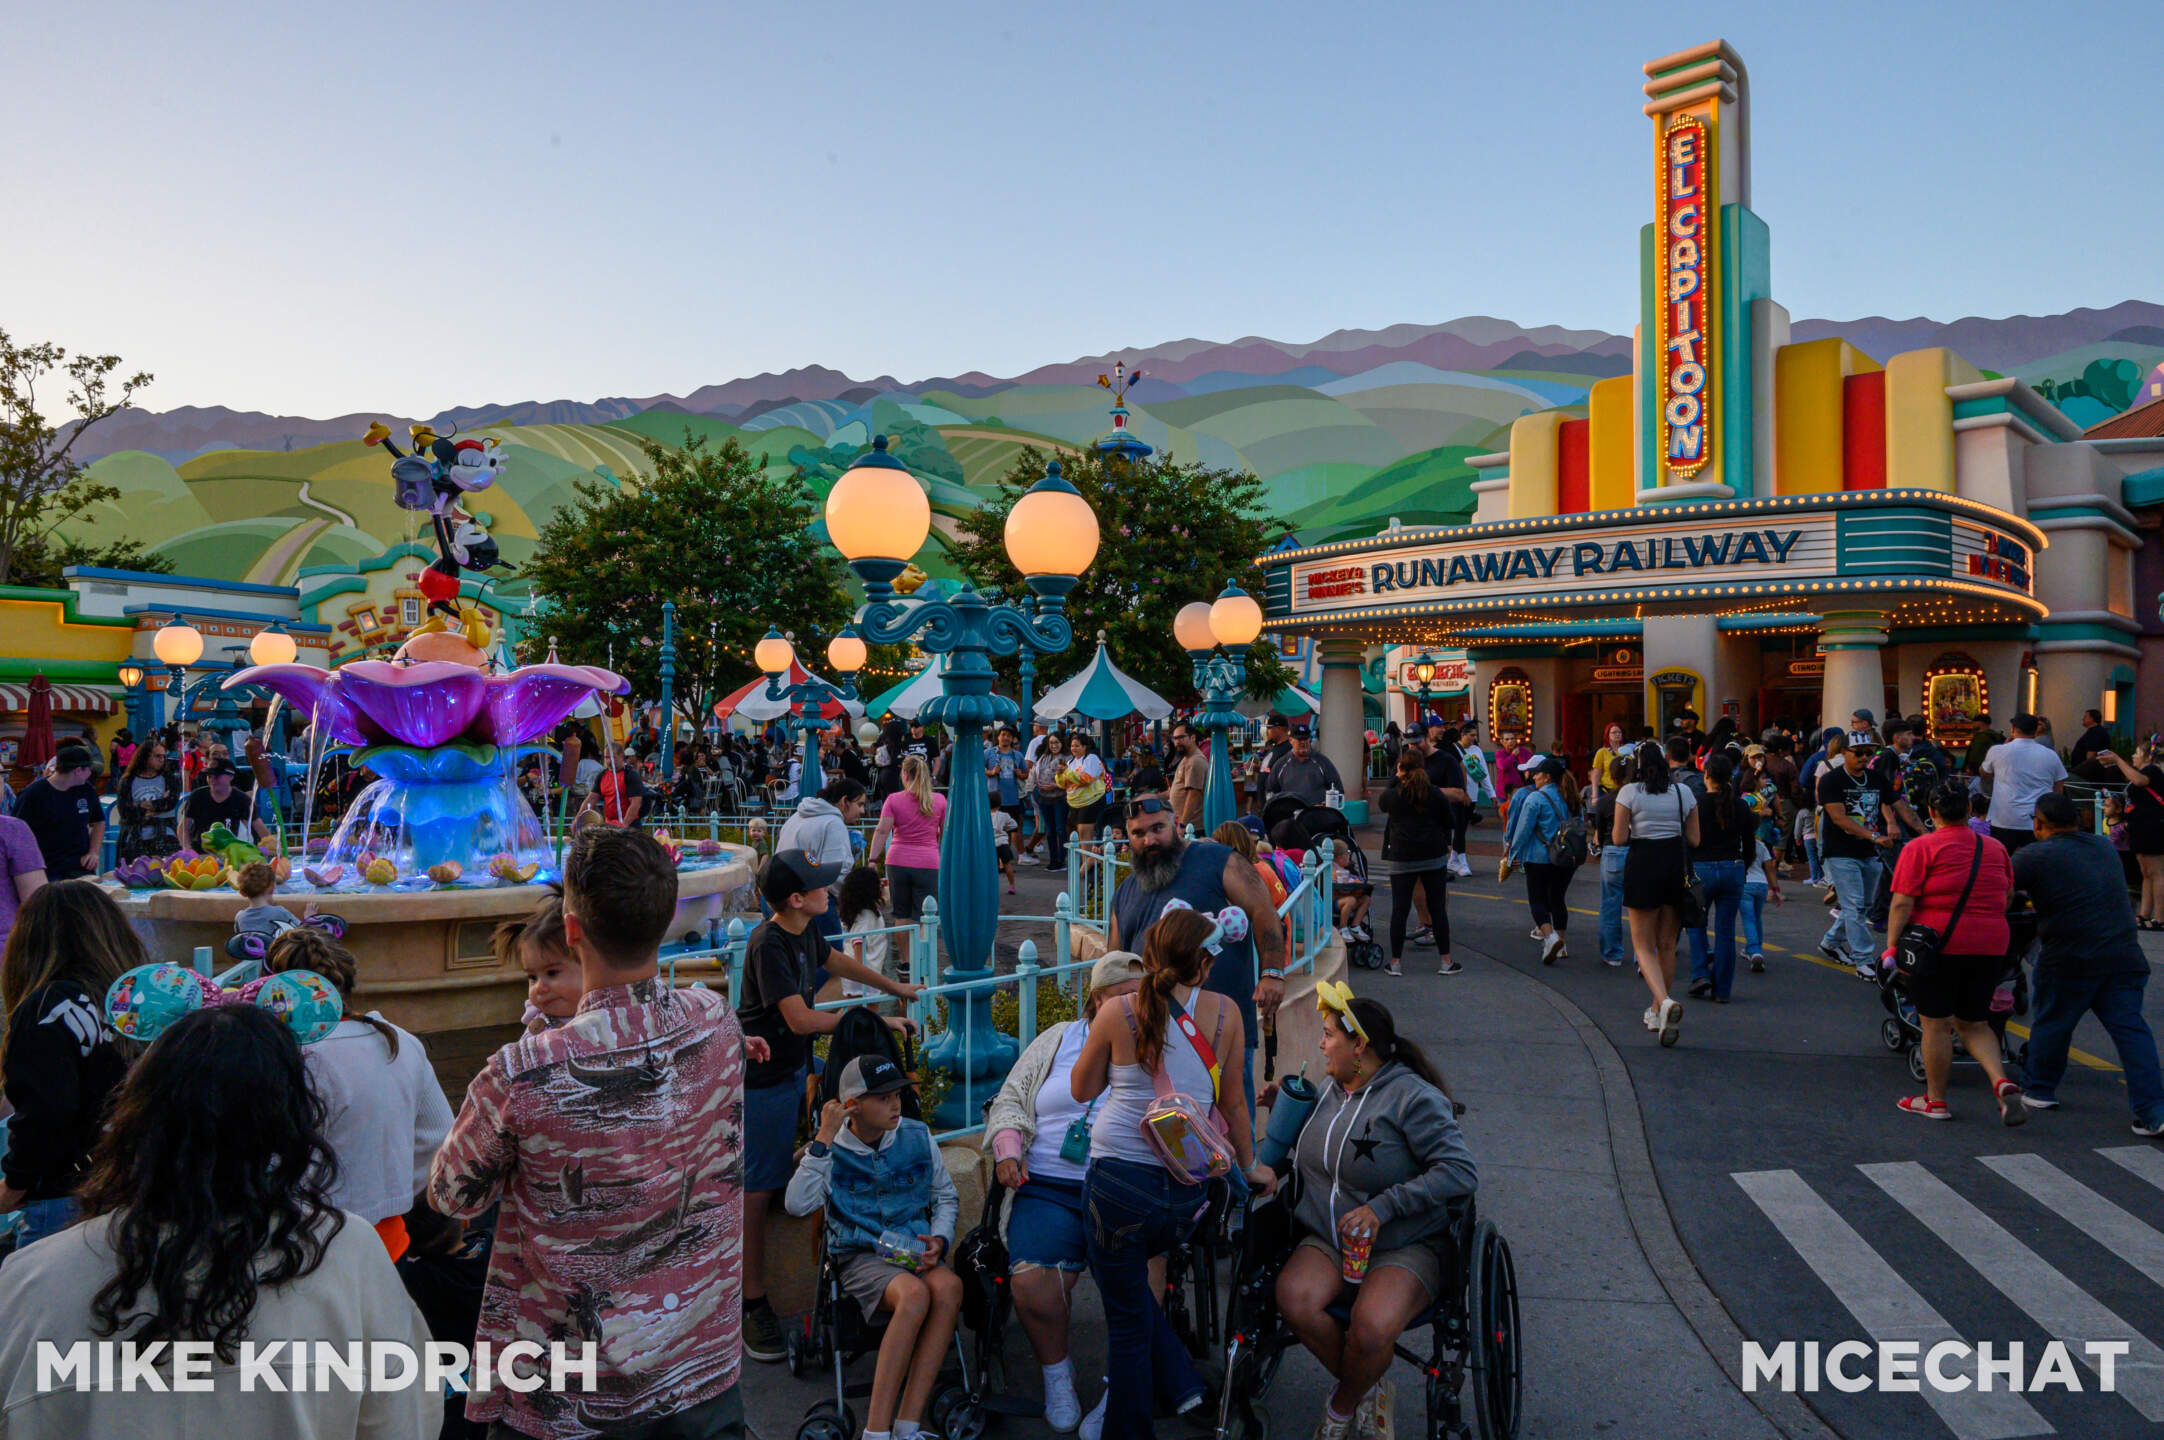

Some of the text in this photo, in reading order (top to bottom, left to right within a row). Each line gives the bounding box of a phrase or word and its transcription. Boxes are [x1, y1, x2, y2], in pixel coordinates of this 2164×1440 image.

[1665, 133, 1706, 459] EL CAPITOON
[1372, 530, 1802, 594] RUNAWAY RAILWAY
[1651, 672, 1697, 686] TICKETS
